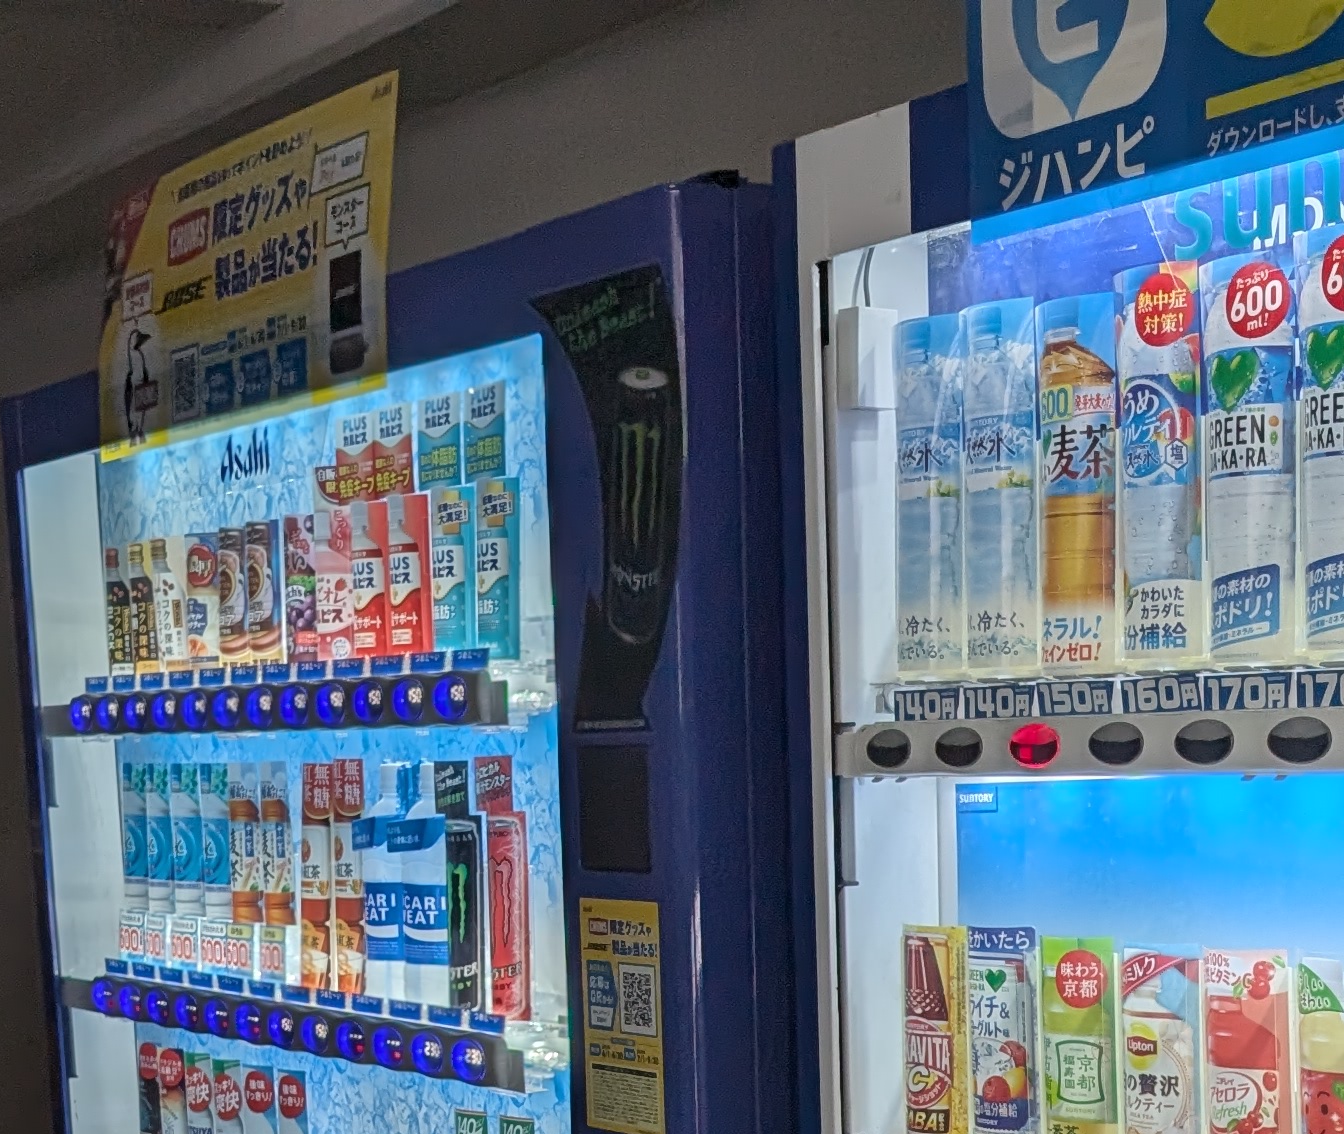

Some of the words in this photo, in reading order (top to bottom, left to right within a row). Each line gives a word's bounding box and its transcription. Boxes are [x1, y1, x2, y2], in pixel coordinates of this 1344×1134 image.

[998, 116, 1155, 211] ジハンピ
[1137, 288, 1188, 315] 熱中症
[1230, 280, 1283, 323] 600
[1142, 314, 1184, 337] 対策!
[425, 397, 450, 415] PLUS
[471, 386, 496, 404] PLUS
[343, 415, 367, 433] PLUS
[379, 407, 403, 424] PLUS
[220, 427, 271, 482] Asahi
[1050, 421, 1115, 483] 麦茶
[1139, 585, 1185, 605] かわいた
[1139, 602, 1185, 621] カラダに
[967, 686, 1031, 717] 140円
[1038, 682, 1112, 715] 150円
[1124, 676, 1200, 712] 160円
[1209, 672, 1289, 710] 170円
[897, 691, 956, 721] 140円
[1062, 979, 1098, 999] 京都
[1126, 1038, 1154, 1053] Lipton
